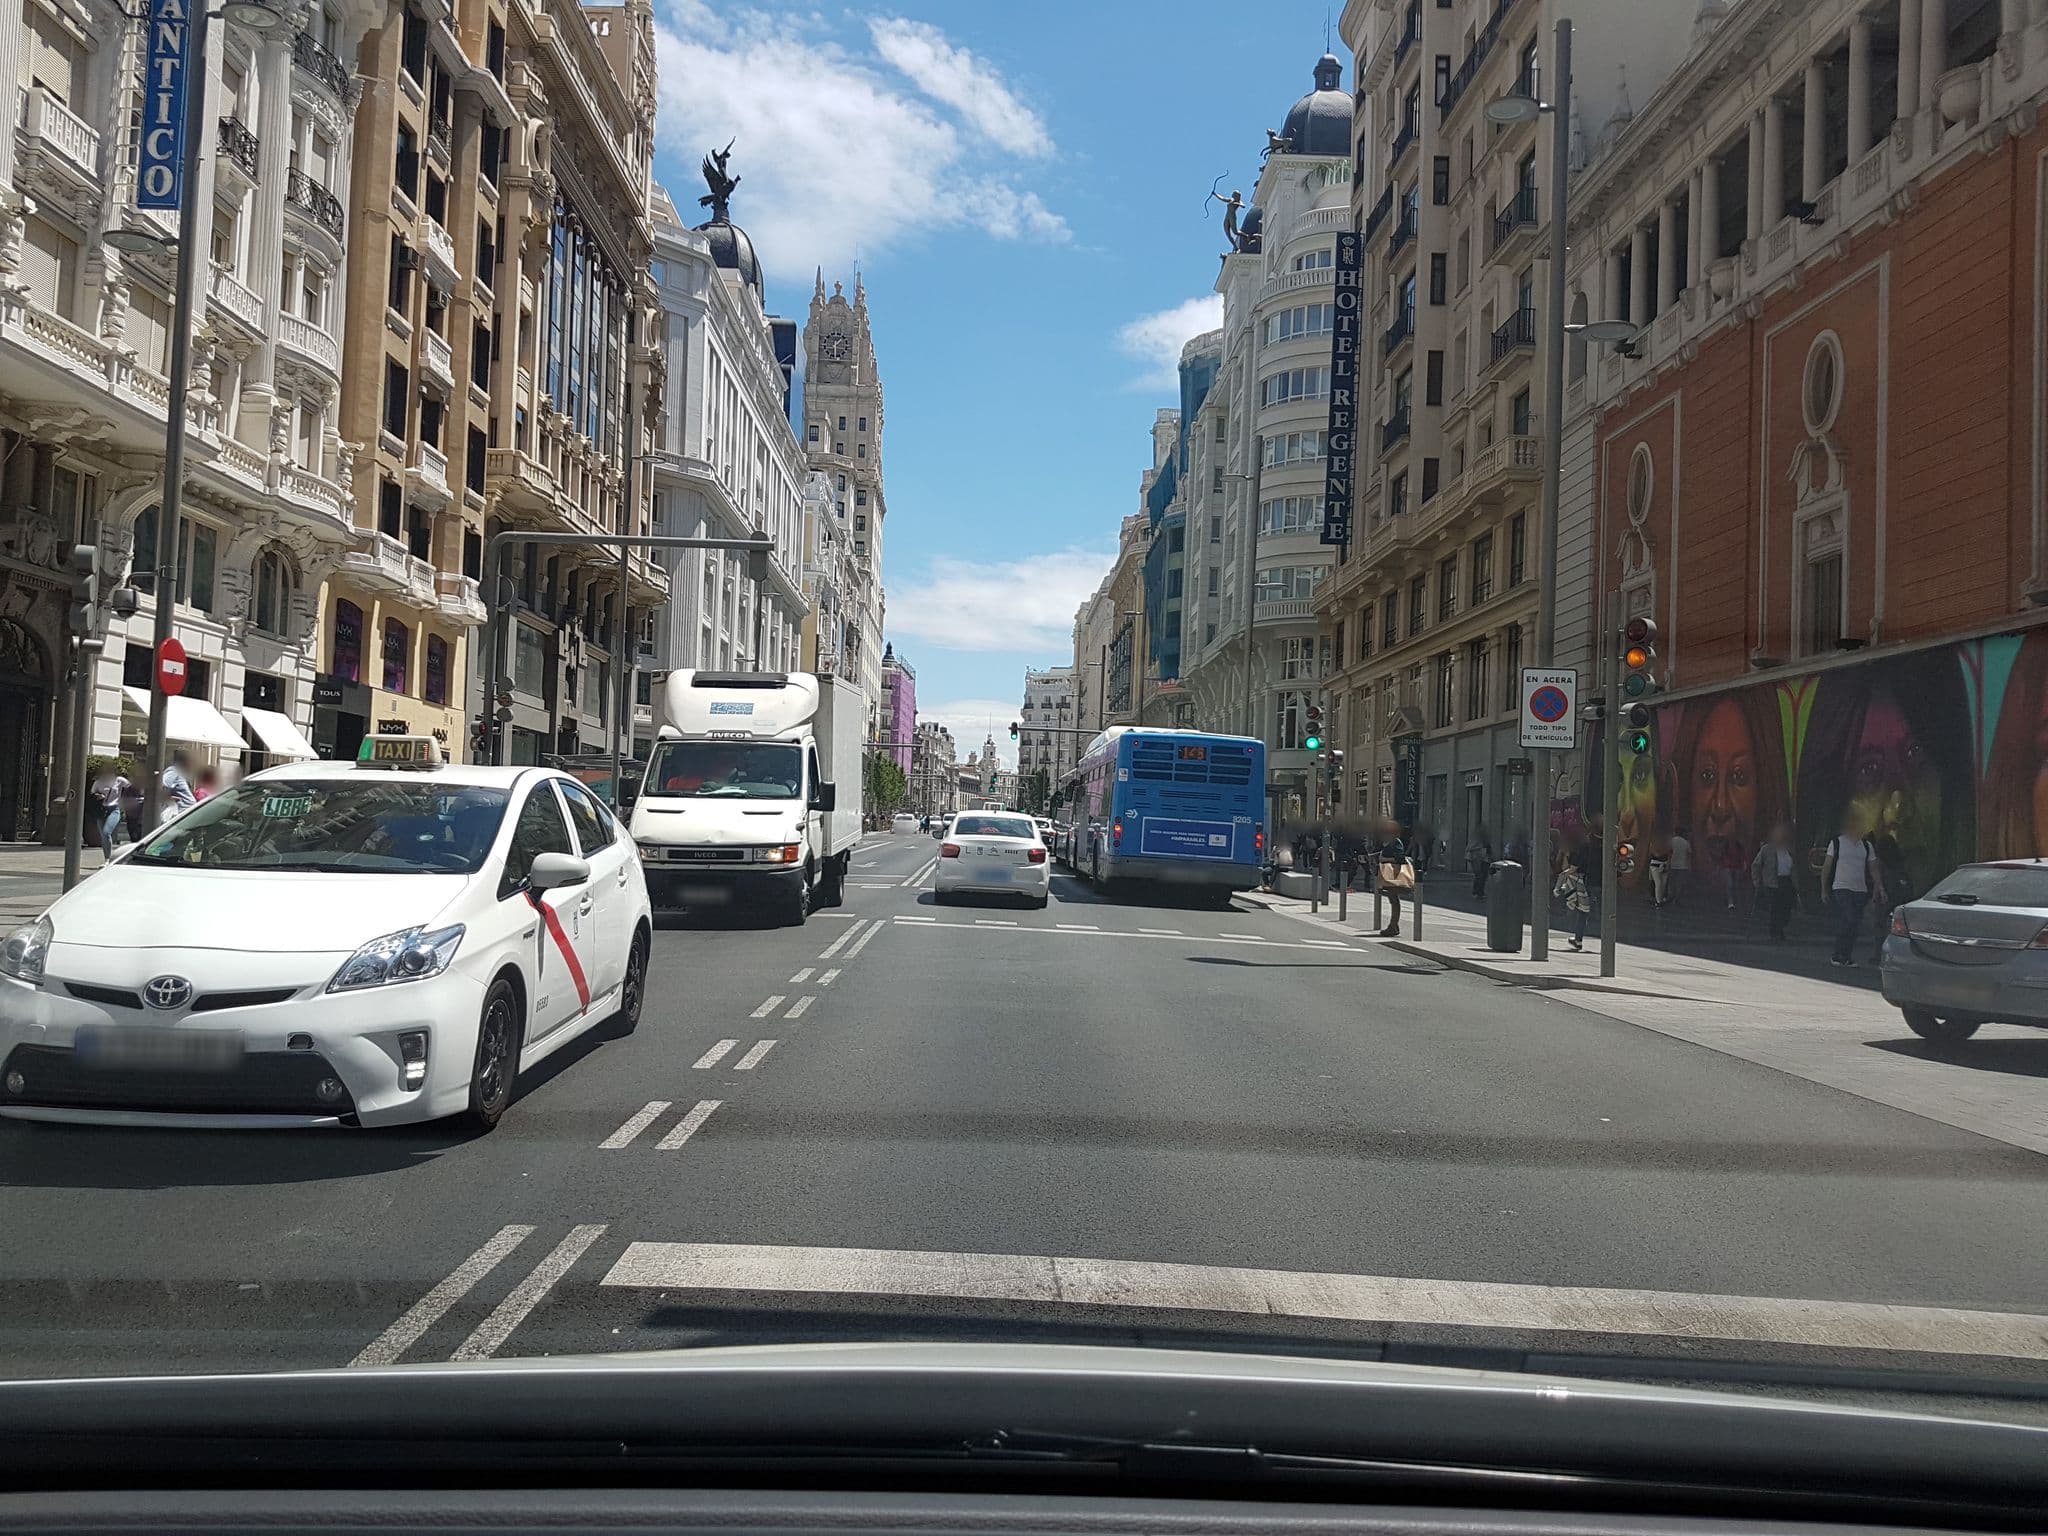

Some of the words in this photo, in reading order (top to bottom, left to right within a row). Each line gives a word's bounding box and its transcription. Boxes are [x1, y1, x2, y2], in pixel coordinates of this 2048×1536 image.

[143, 0, 186, 197] ANTICO
[1335, 270, 1358, 376] HOTEL
[1327, 388, 1351, 540] REGENTE
[319, 689, 341, 697] TOUS
[1526, 675, 1538, 683] EN
[1543, 676, 1573, 684] ACERA
[376, 741, 411, 759] TAXI
[1408, 746, 1417, 800] ANDORRA
